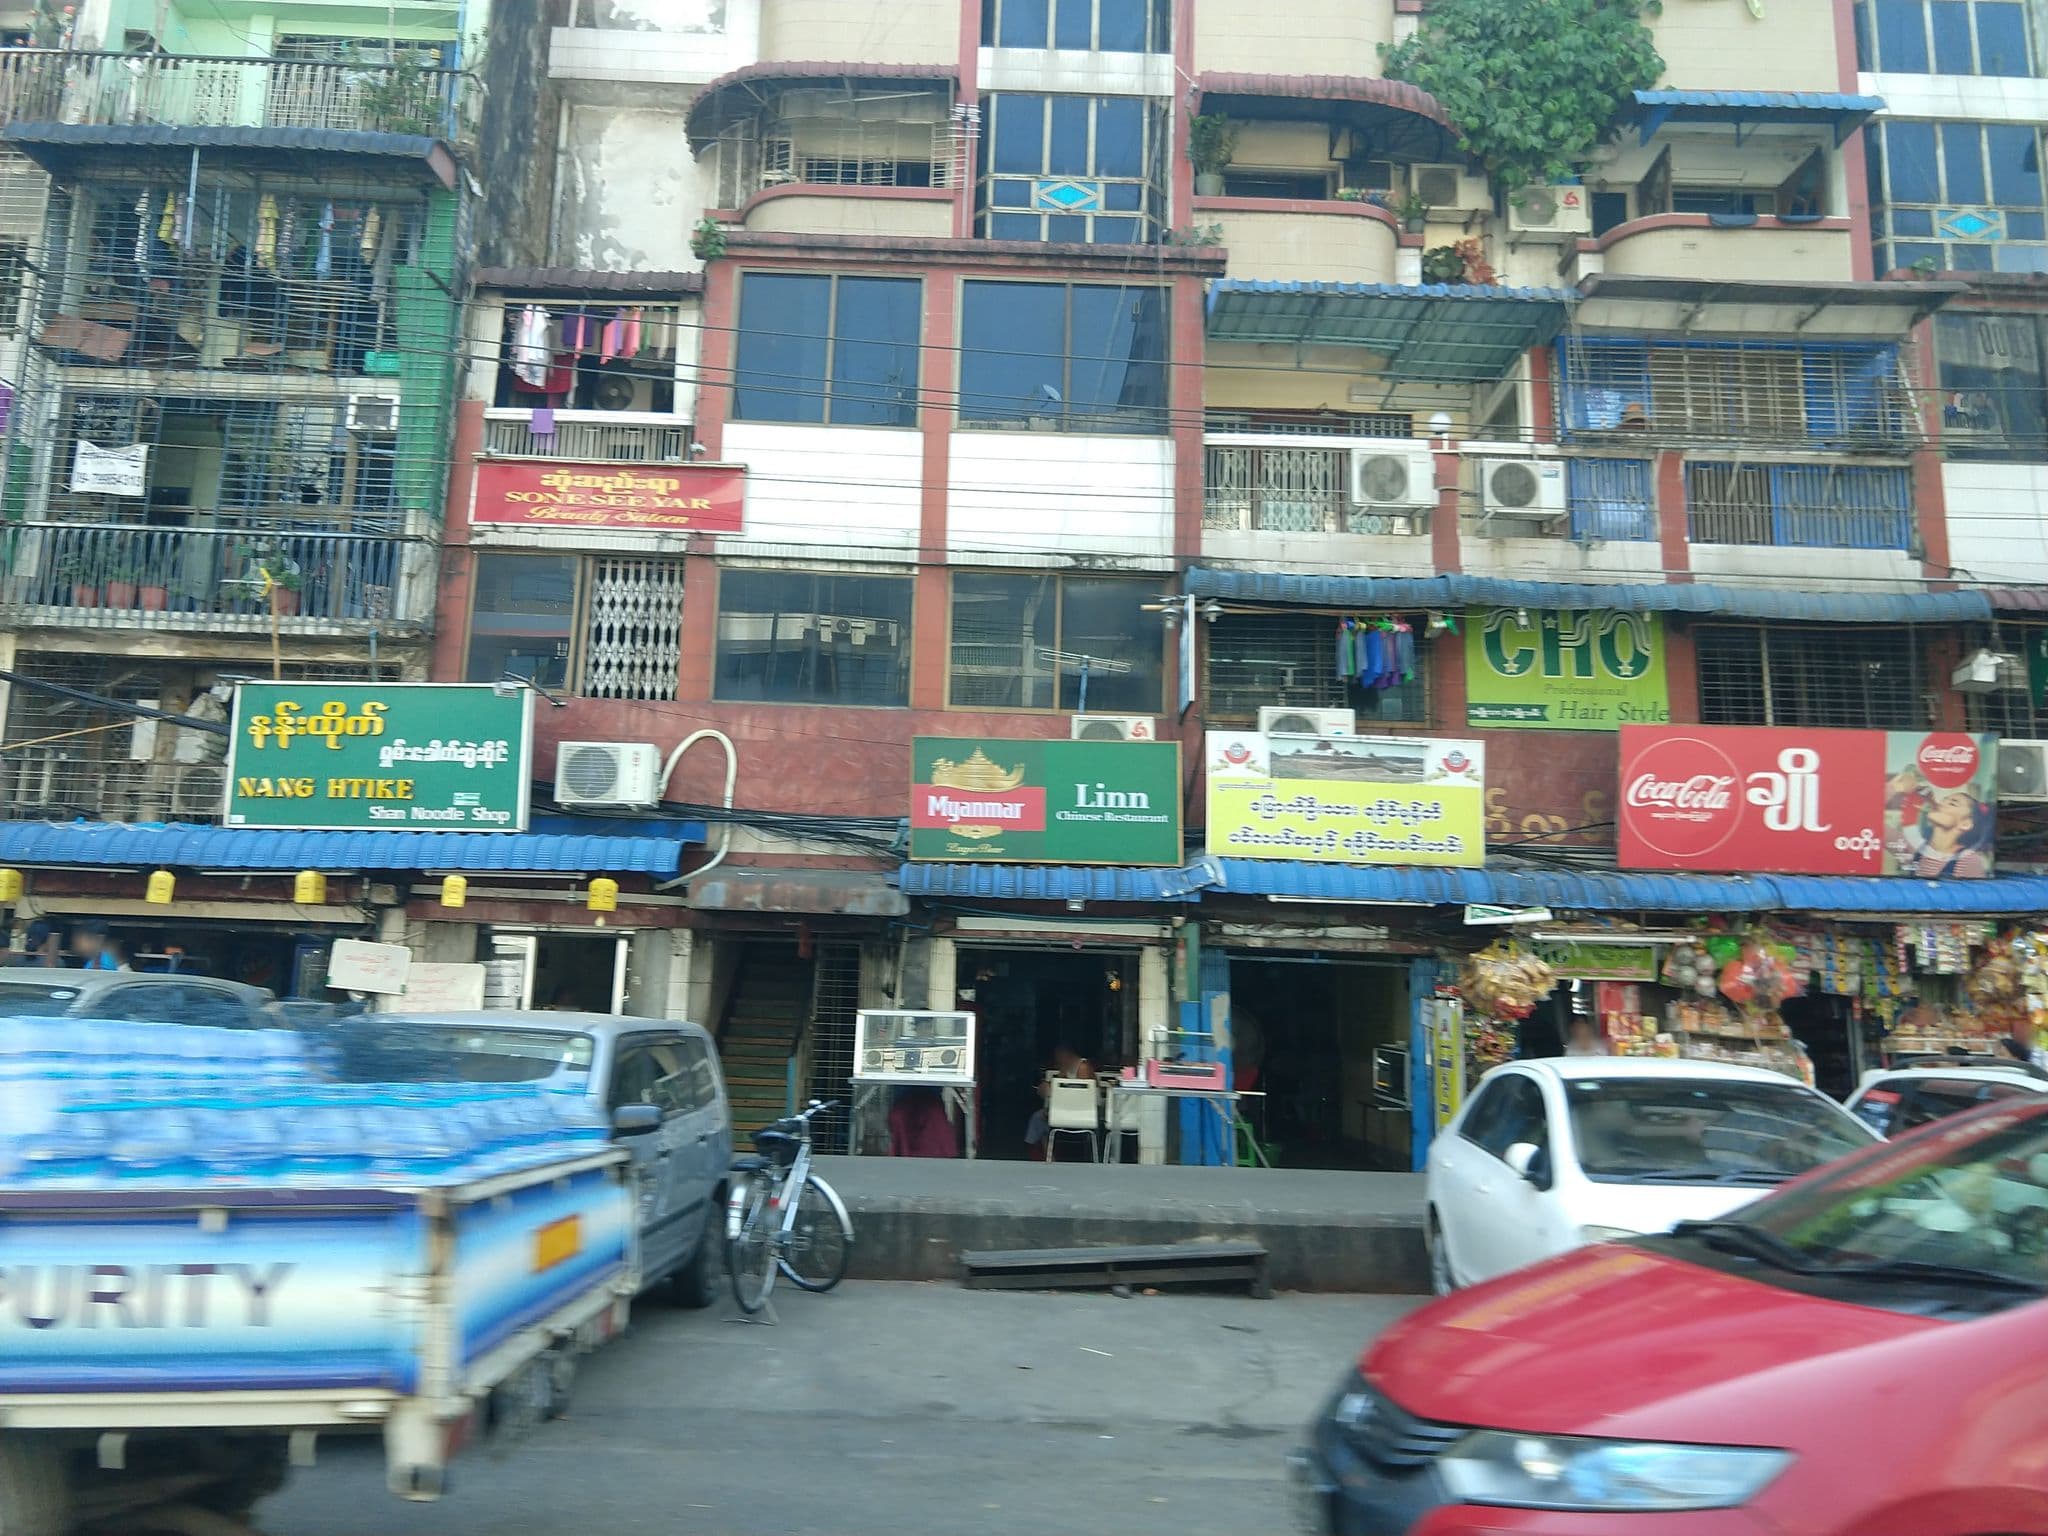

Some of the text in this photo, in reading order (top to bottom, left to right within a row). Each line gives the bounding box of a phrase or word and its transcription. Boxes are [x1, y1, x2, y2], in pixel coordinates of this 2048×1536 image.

[504, 490, 711, 510] SONE SEE YAR
[524, 506, 689, 524] Beauty Saloon
[1483, 606, 1651, 680] CHO
[1557, 700, 1609, 720] Hair
[1617, 701, 1670, 722] Style
[248, 701, 389, 750] နန်းထိုက်
[237, 777, 415, 800] NANG HTIKE
[1074, 783, 1151, 809] Linn
[1627, 773, 1736, 809] Coca-Cola
[1745, 747, 1832, 833] ချို
[368, 805, 511, 824] Shan Noodle Shop
[927, 795, 1025, 822] Myanmar
[1056, 810, 1103, 821] Chinese
[0, 1262, 298, 1329] URITY
